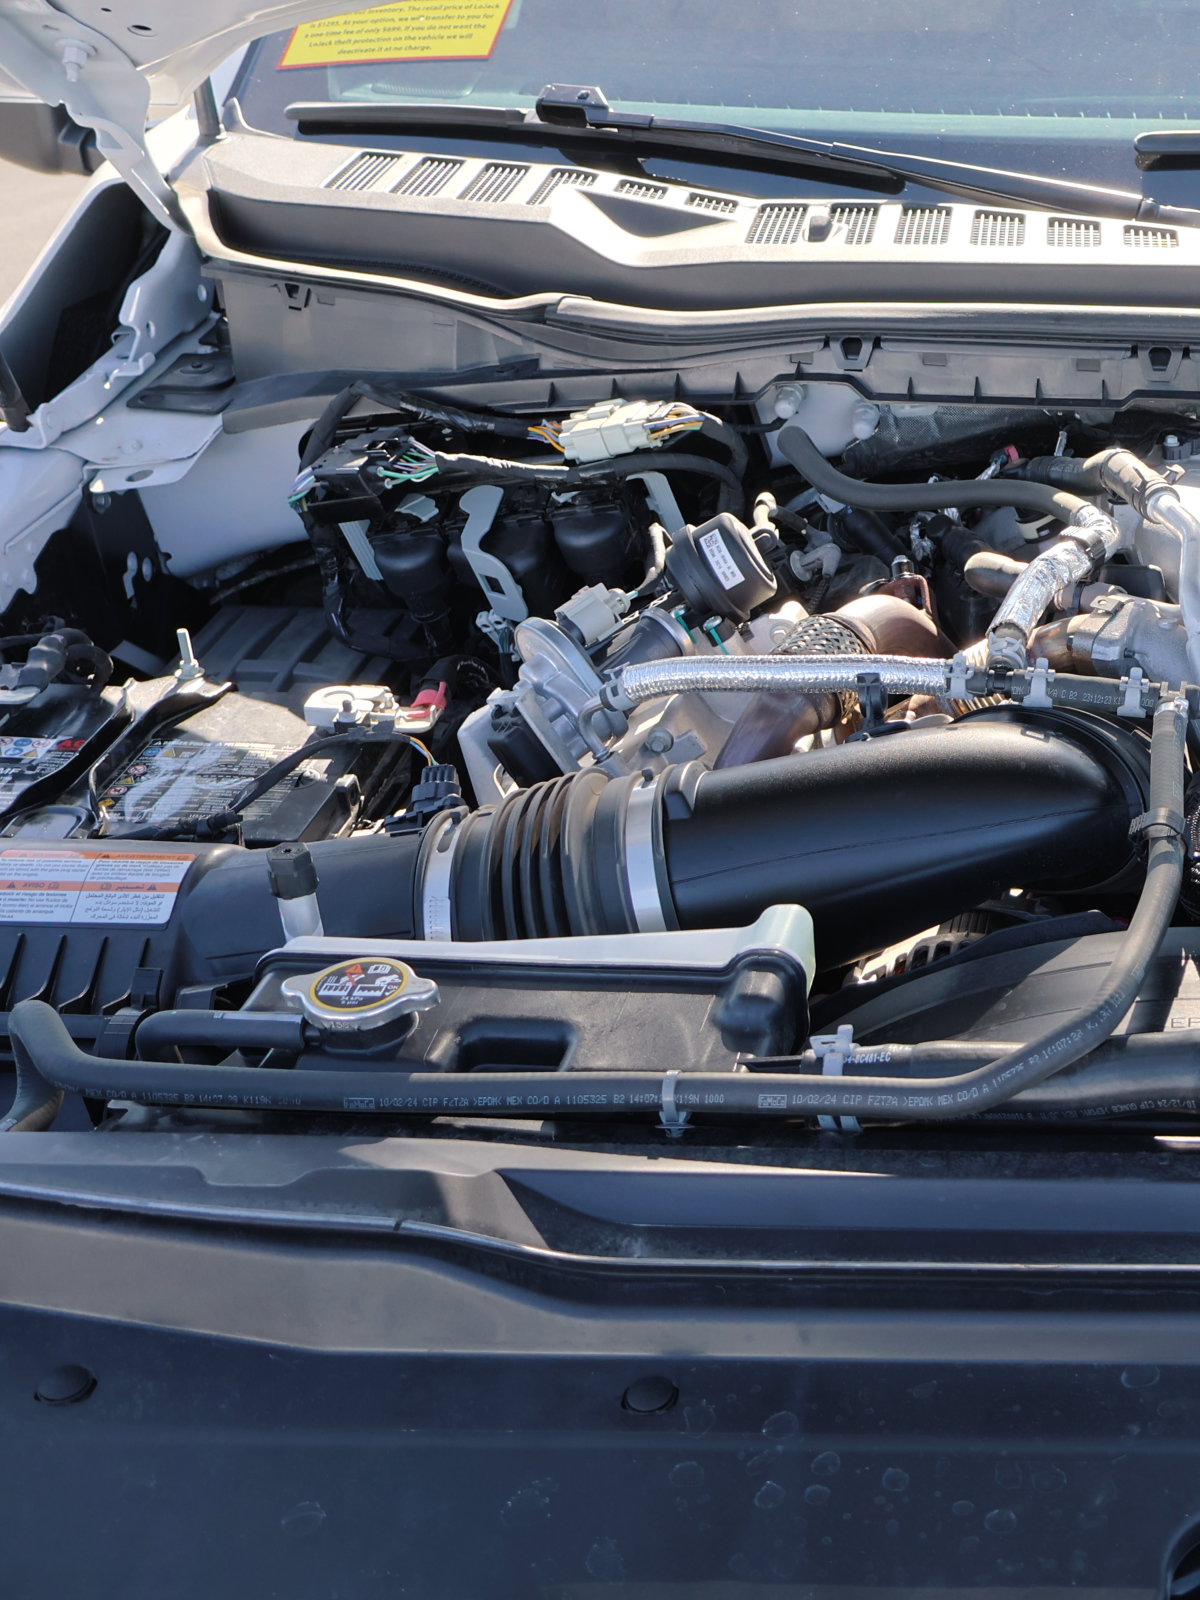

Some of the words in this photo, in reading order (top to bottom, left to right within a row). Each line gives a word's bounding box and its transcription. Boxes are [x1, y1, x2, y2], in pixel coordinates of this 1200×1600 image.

[791, 1094, 838, 1106] 10/02/24
[842, 1094, 863, 1106] CIP
[937, 1093, 954, 1107] MEX
